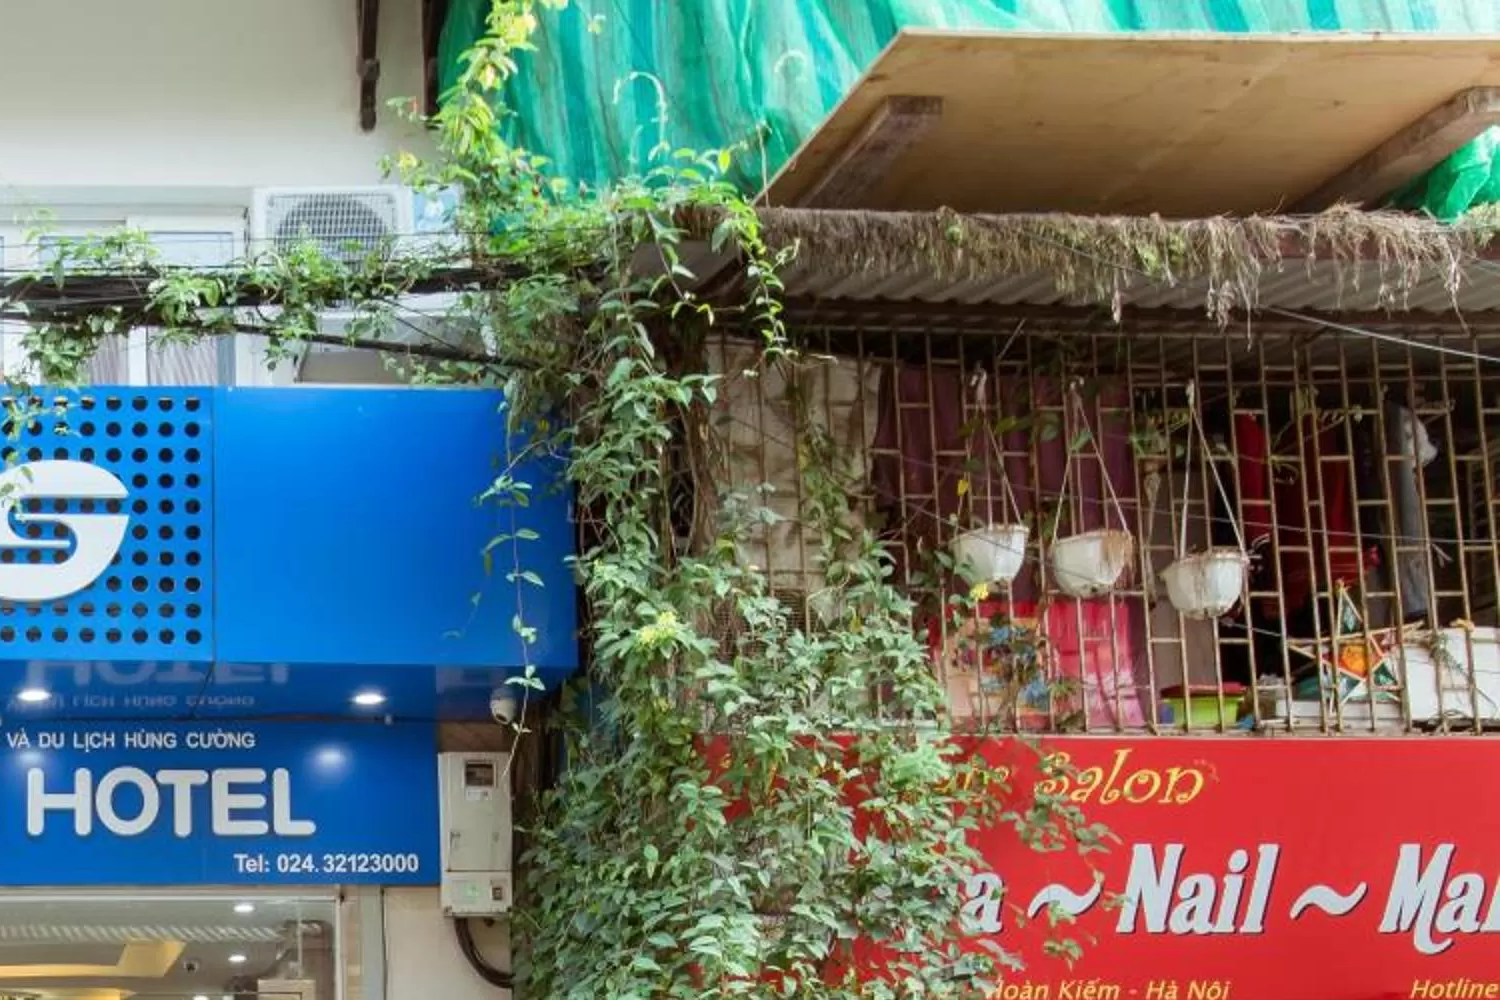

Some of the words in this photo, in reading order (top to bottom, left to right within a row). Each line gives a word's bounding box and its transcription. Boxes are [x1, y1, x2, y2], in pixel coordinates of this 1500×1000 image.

[7, 728, 30, 748] VÀ
[38, 732, 64, 748] DU
[73, 732, 115, 752] LỊCH
[124, 728, 177, 748] HÙNG
[186, 728, 256, 748] CƯỜNG
[26, 766, 317, 838] HOTEL
[233, 853, 271, 873] Tel:
[1116, 842, 1280, 937] Nail
[1059, 977, 1120, 1000] Kiếm
